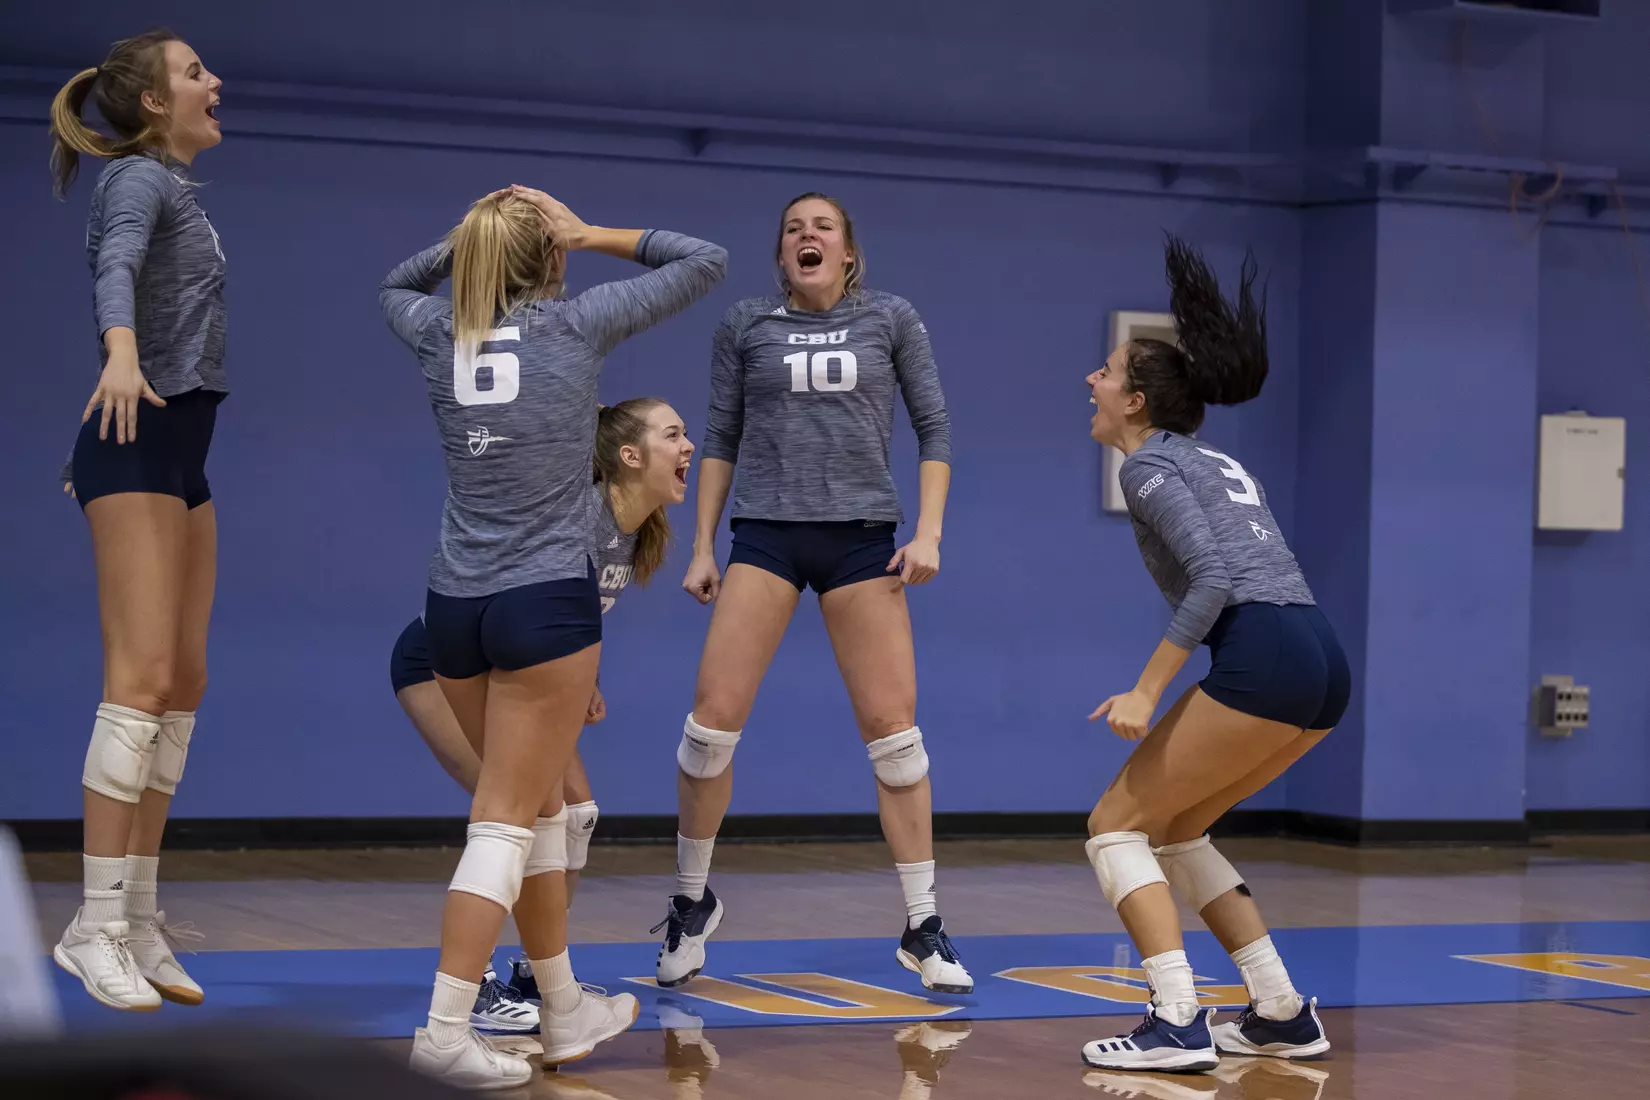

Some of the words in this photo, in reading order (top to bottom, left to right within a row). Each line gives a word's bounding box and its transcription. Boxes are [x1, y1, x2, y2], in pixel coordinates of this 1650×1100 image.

[787, 328, 849, 344] CBU
[453, 326, 521, 406] 6
[783, 350, 858, 392] 10
[1138, 473, 1165, 498] WAC
[1195, 446, 1261, 506] 3
[599, 564, 634, 590] CBU
